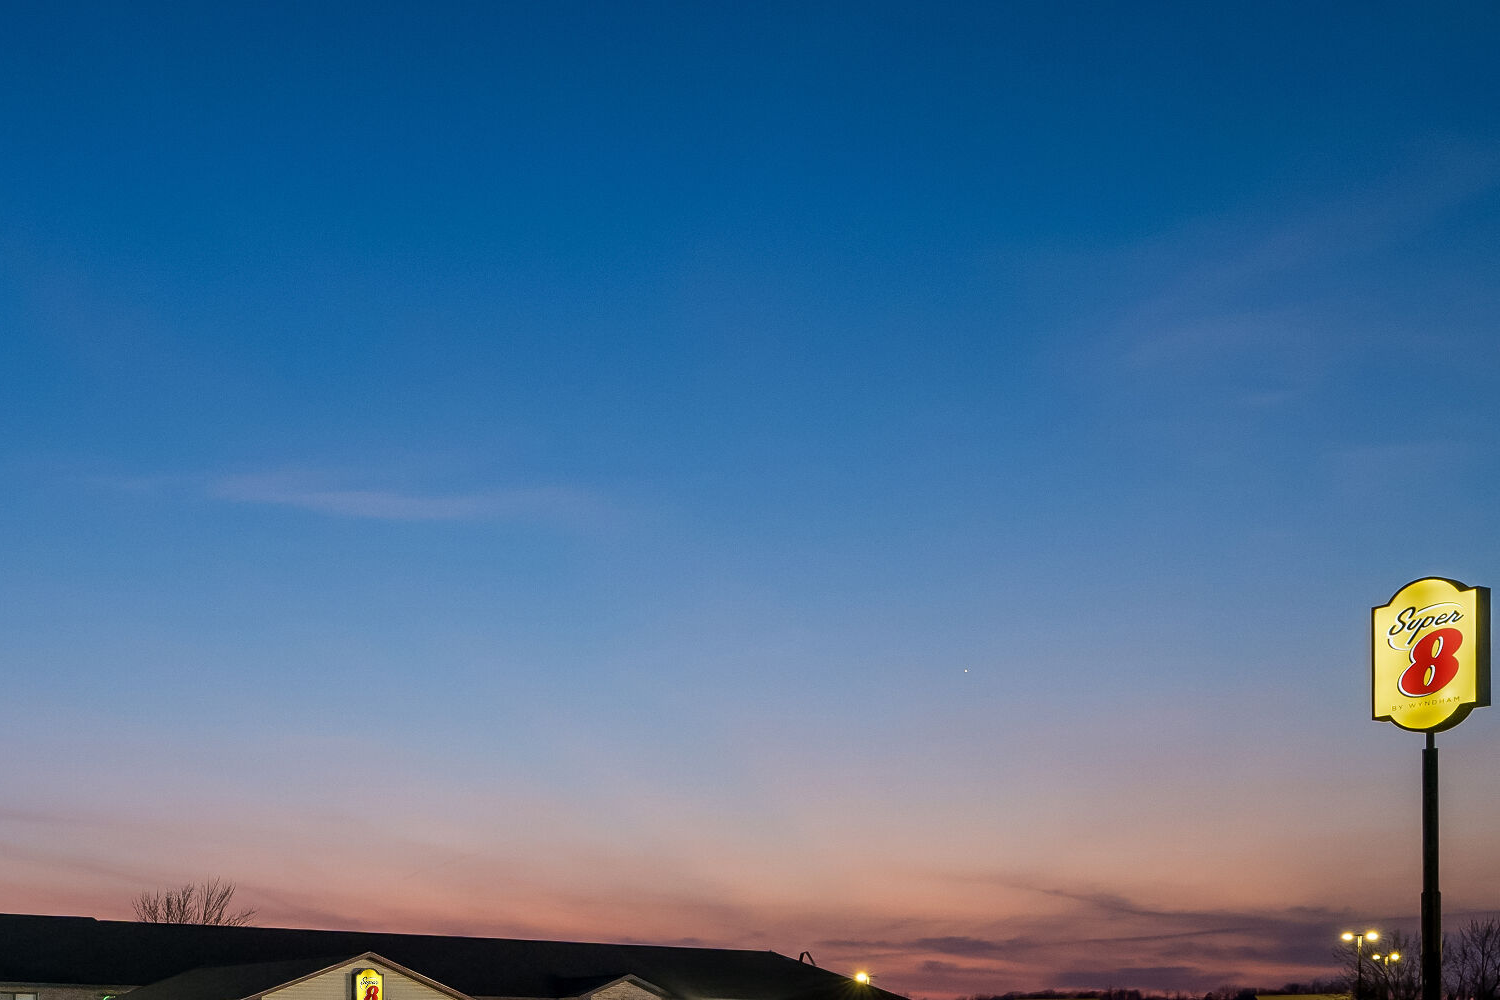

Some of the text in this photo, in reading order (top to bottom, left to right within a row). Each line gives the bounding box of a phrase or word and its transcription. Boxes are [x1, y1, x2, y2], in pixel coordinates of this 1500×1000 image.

[1388, 605, 1464, 646] Super
[1398, 628, 1463, 697] 8
[1392, 695, 1460, 712] BY WYNDHAM
